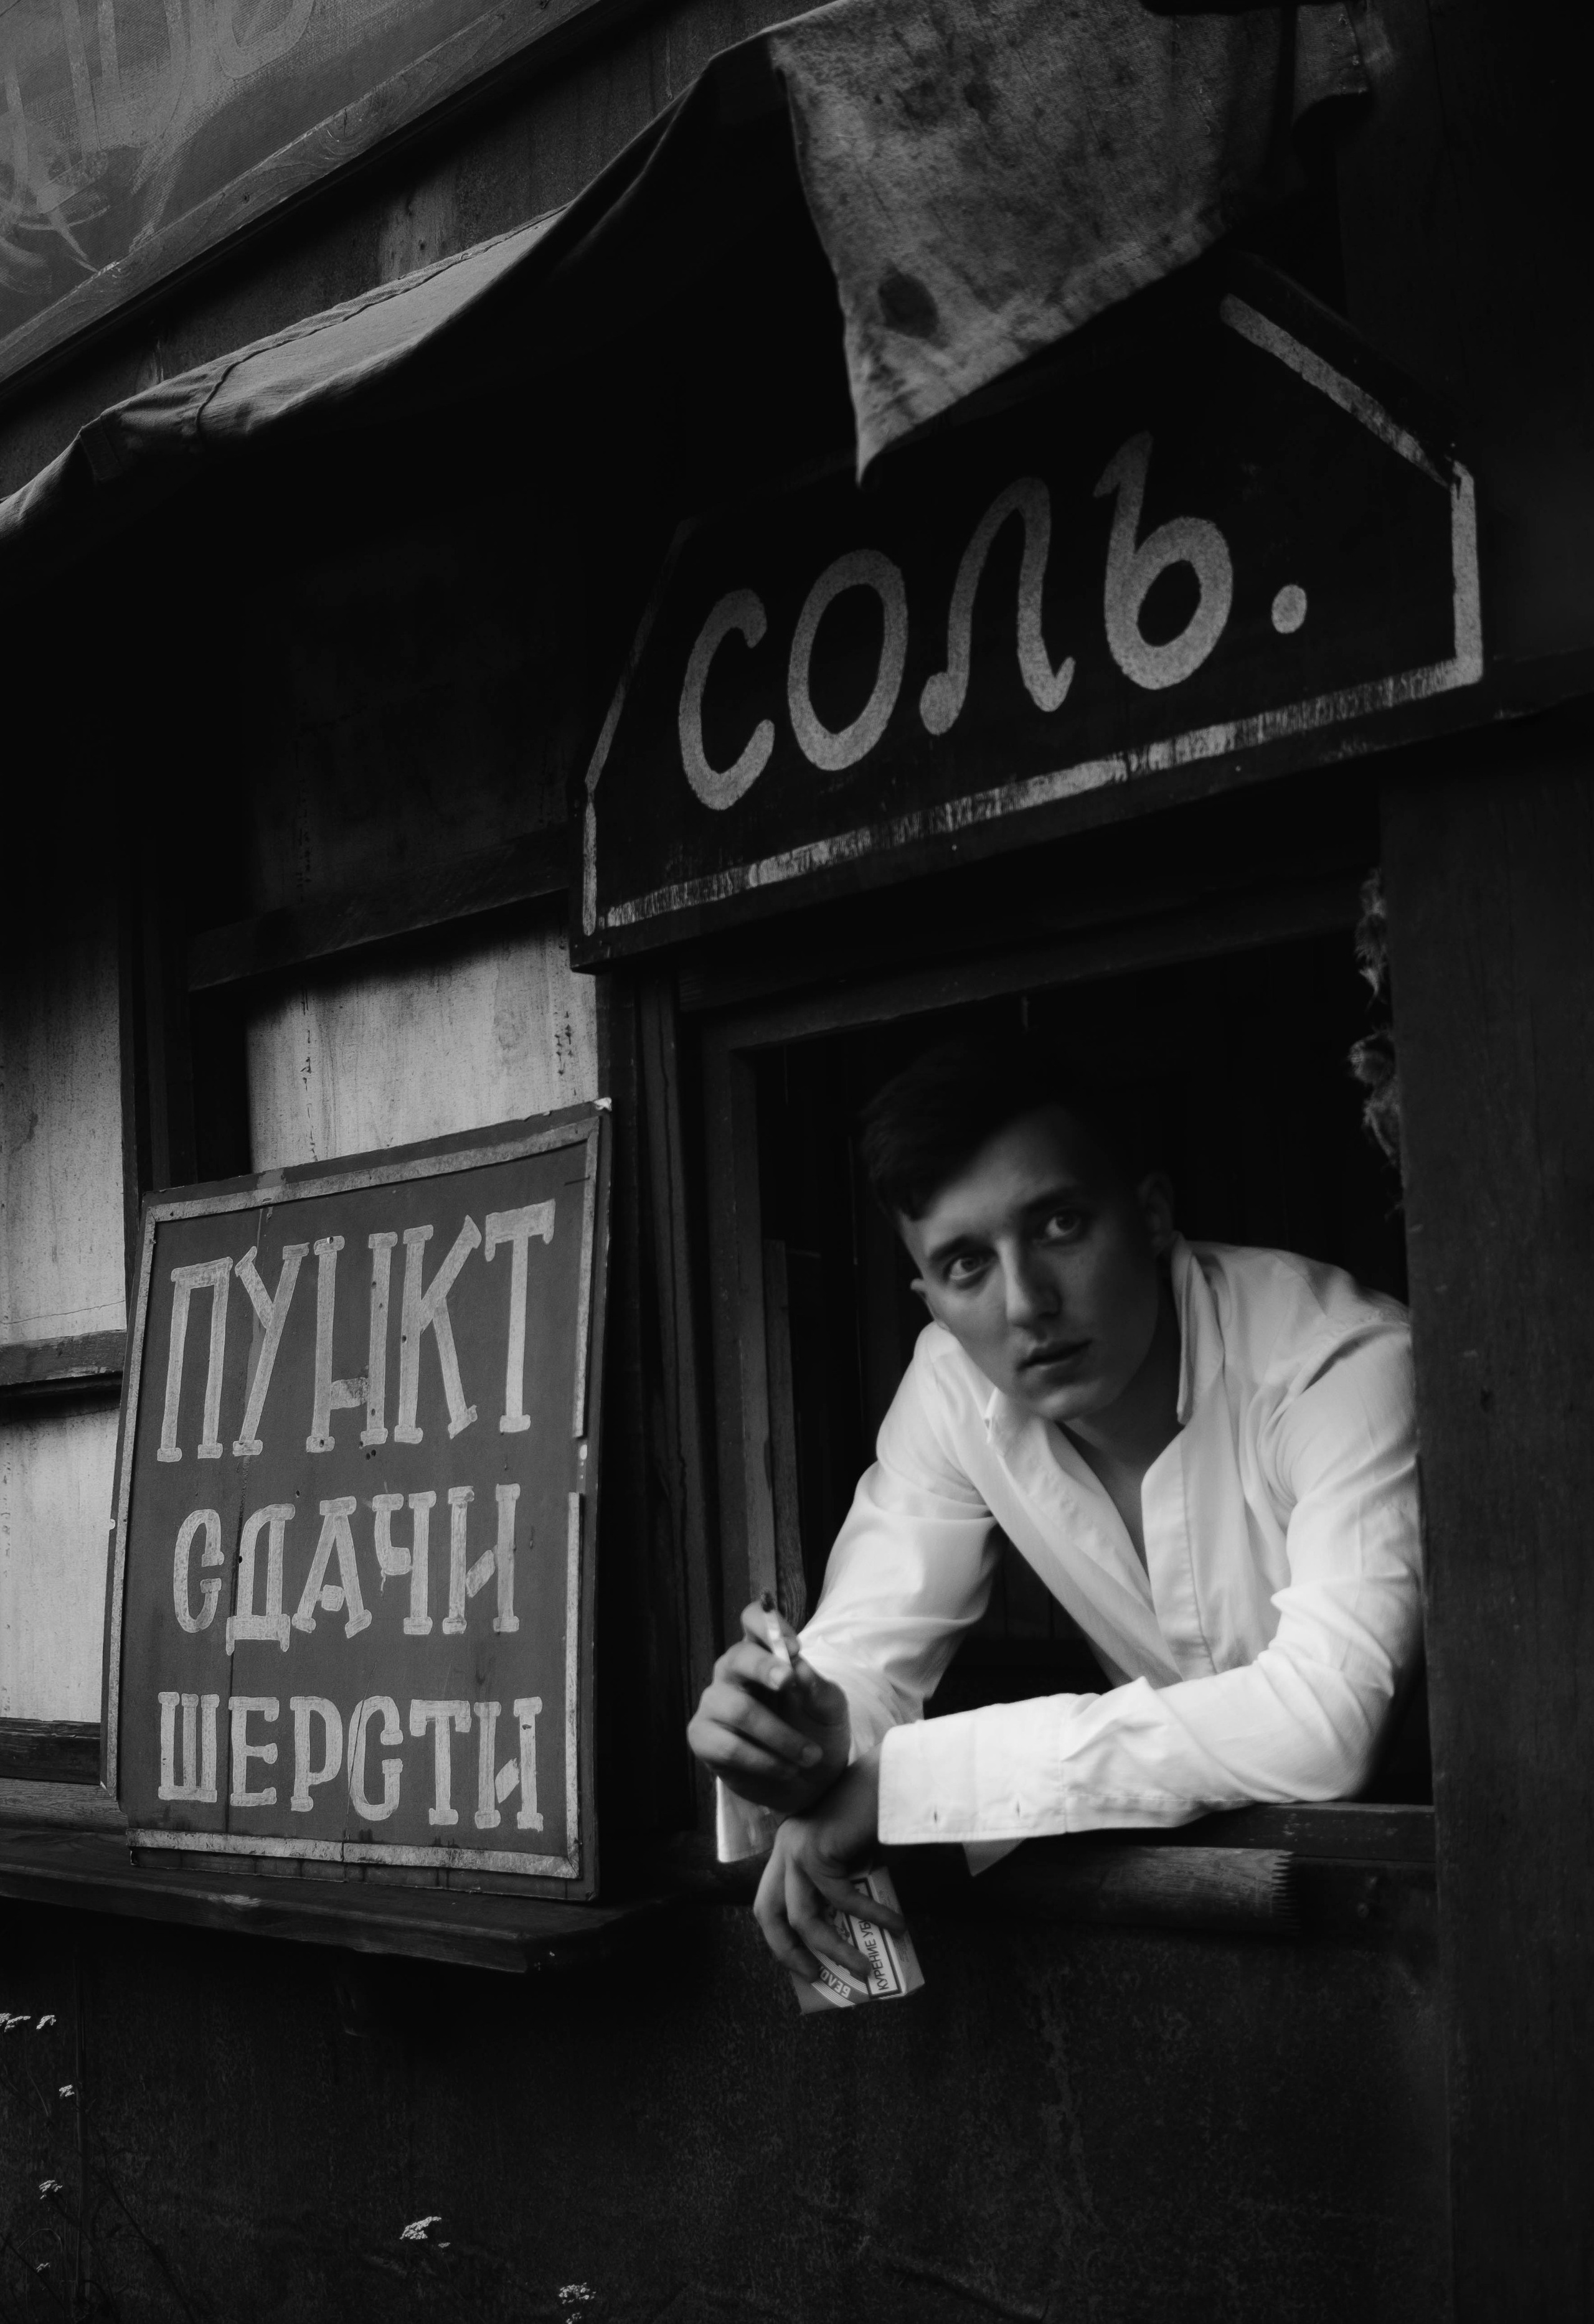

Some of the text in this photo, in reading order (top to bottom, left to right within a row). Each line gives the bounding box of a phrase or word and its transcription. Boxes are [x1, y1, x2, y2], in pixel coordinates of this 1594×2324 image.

[157, 1198, 556, 1462] ПУНКТ
[172, 1483, 521, 1656] СДАЧИ
[158, 1691, 544, 1831] ШЕРСТИ
[819, 1965, 851, 1998] БЕЛО
[864, 1939, 889, 1991] КУРЕНИЕ
